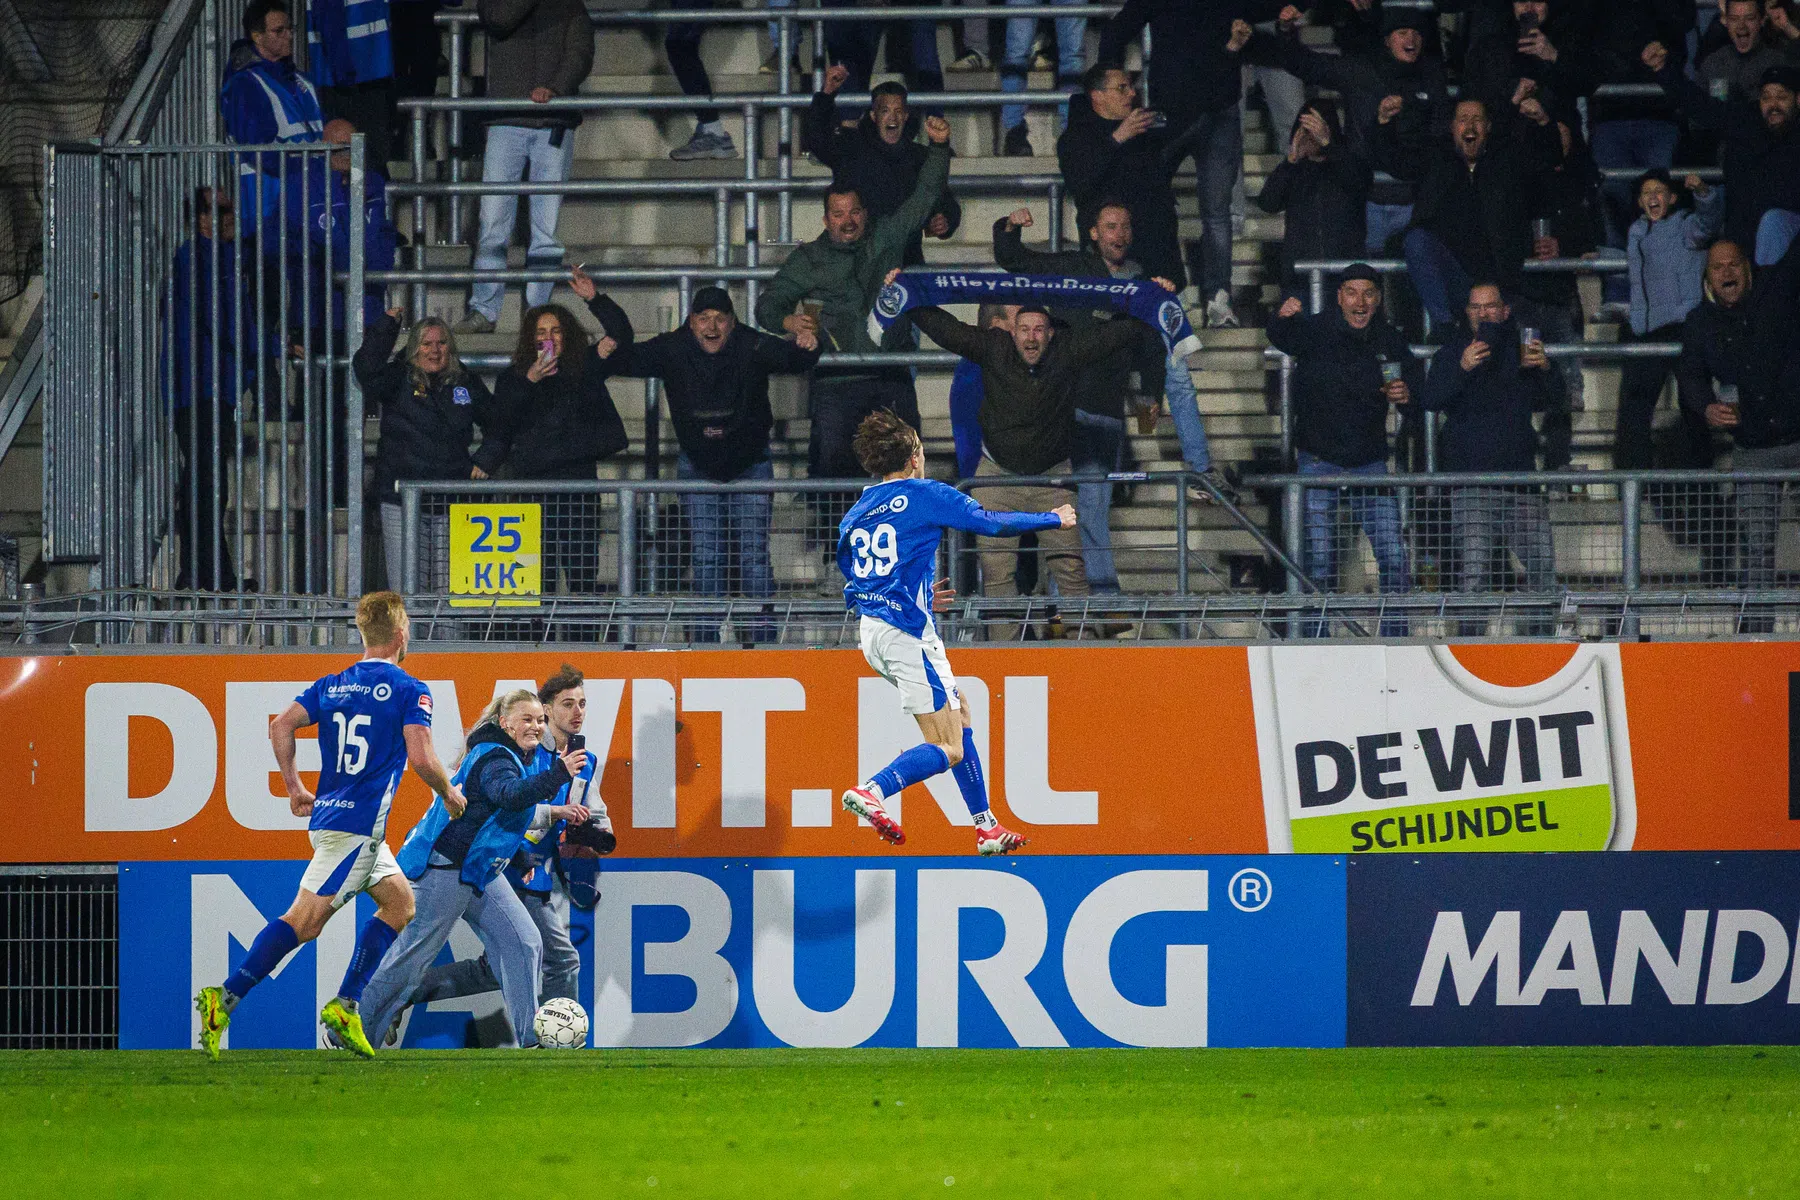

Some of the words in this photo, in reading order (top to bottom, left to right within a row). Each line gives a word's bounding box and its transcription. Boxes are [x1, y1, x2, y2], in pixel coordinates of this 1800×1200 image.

[470, 515, 522, 553] 25
[849, 523, 899, 578] 39
[332, 711, 371, 775] 15
[1295, 731, 1408, 809] DE
[1416, 710, 1595, 793] WIT
[1350, 800, 1559, 852] SCHIJNDEL
[1410, 909, 1800, 1006] MAND
